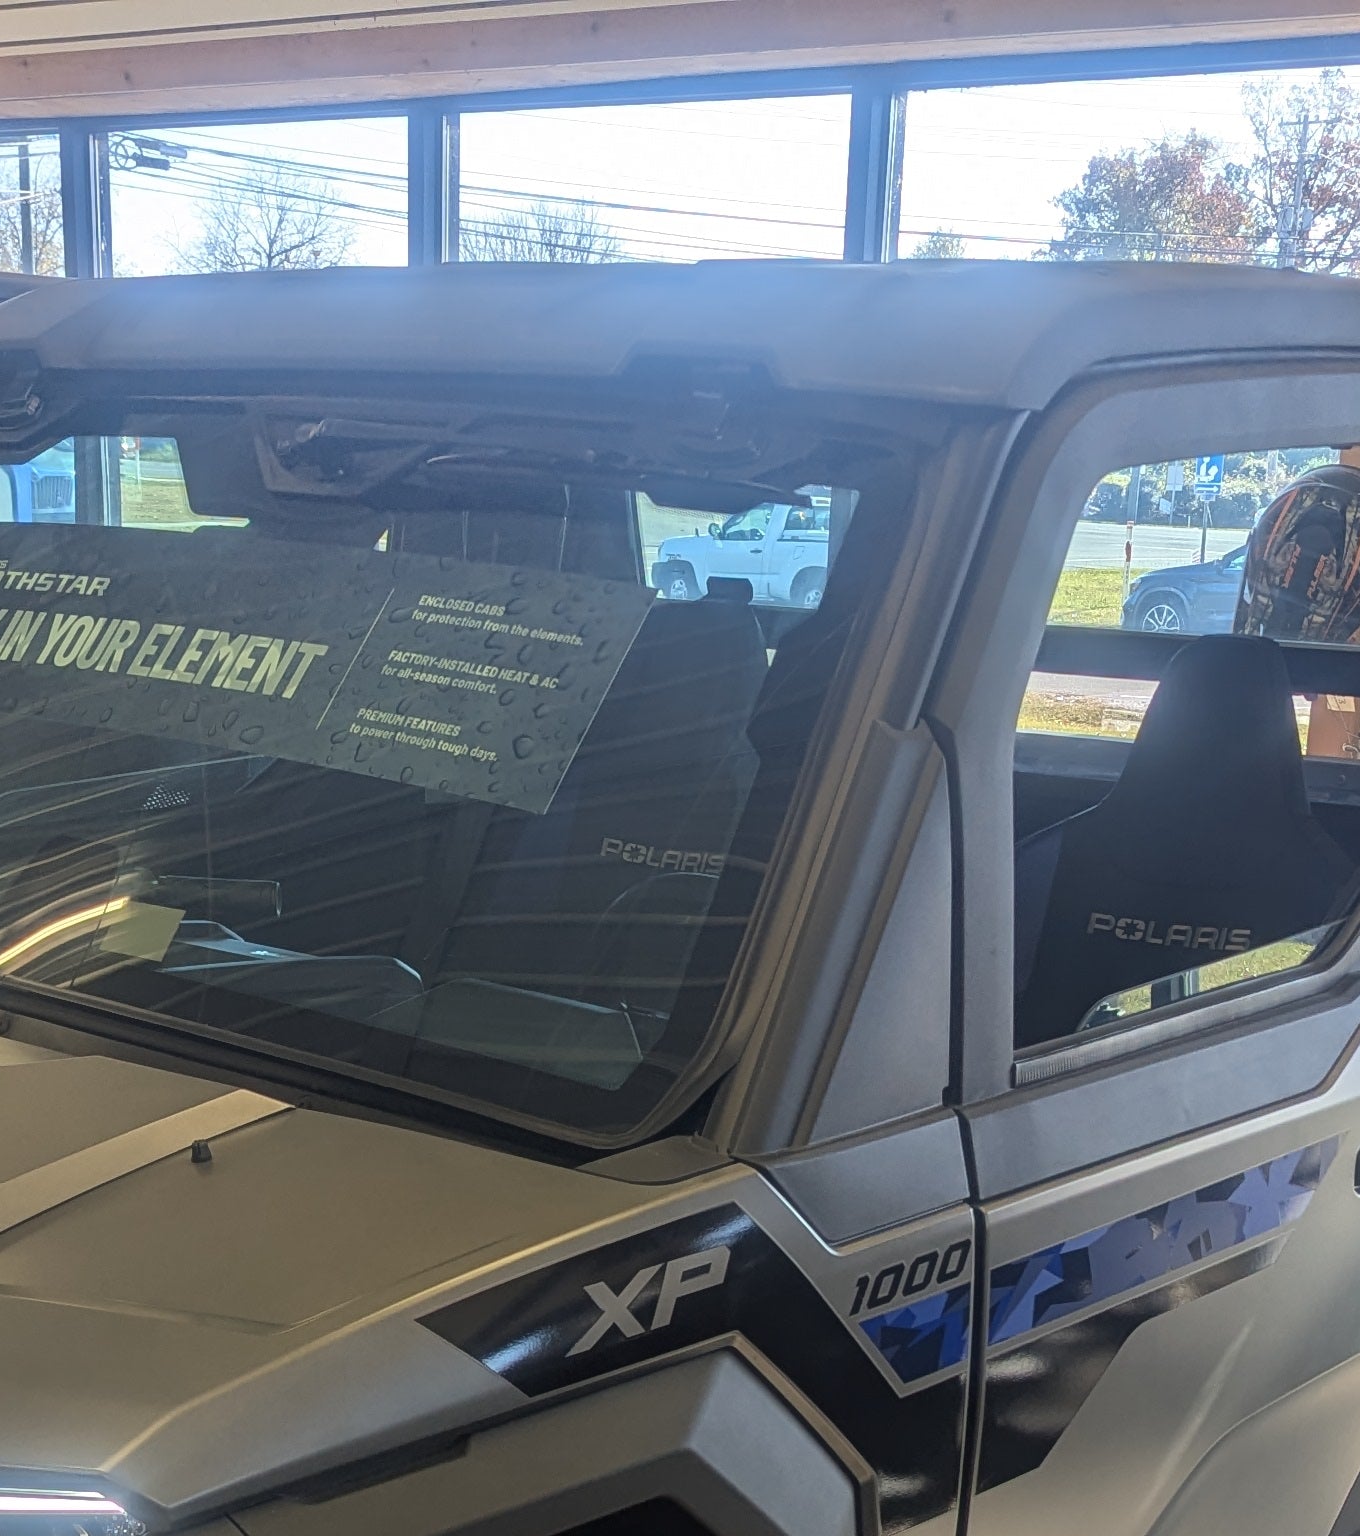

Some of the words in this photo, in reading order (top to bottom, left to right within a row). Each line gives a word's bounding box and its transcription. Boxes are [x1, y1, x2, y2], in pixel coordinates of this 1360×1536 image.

[418, 594, 476, 613] ENCLOSED
[474, 602, 506, 617] CABS
[411, 608, 428, 621] for
[426, 611, 483, 630] protection
[482, 618, 511, 634] from
[510, 623, 530, 638] the
[529, 627, 585, 647] elements.
[34, 612, 140, 674] YOUR
[126, 622, 330, 700] ELEMENT
[388, 649, 499, 679] FACTORY-INSTALLED
[497, 668, 531, 685] HEAT
[529, 673, 538, 685] &
[538, 676, 560, 690] AC
[380, 663, 397, 677] for
[396, 667, 452, 686] all-season
[451, 675, 498, 695] comfort.
[349, 721, 362, 734] to
[360, 725, 395, 741] power
[394, 729, 438, 749] through
[437, 738, 470, 757] tough
[469, 744, 499, 763] days.
[356, 707, 407, 727] PREMIUM
[403, 715, 462, 737] FEATURES
[600, 836, 727, 873] POLARIS
[1086, 911, 1252, 951] POLARIS
[849, 1238, 972, 1318] 1000
[564, 1245, 731, 1358] XP
